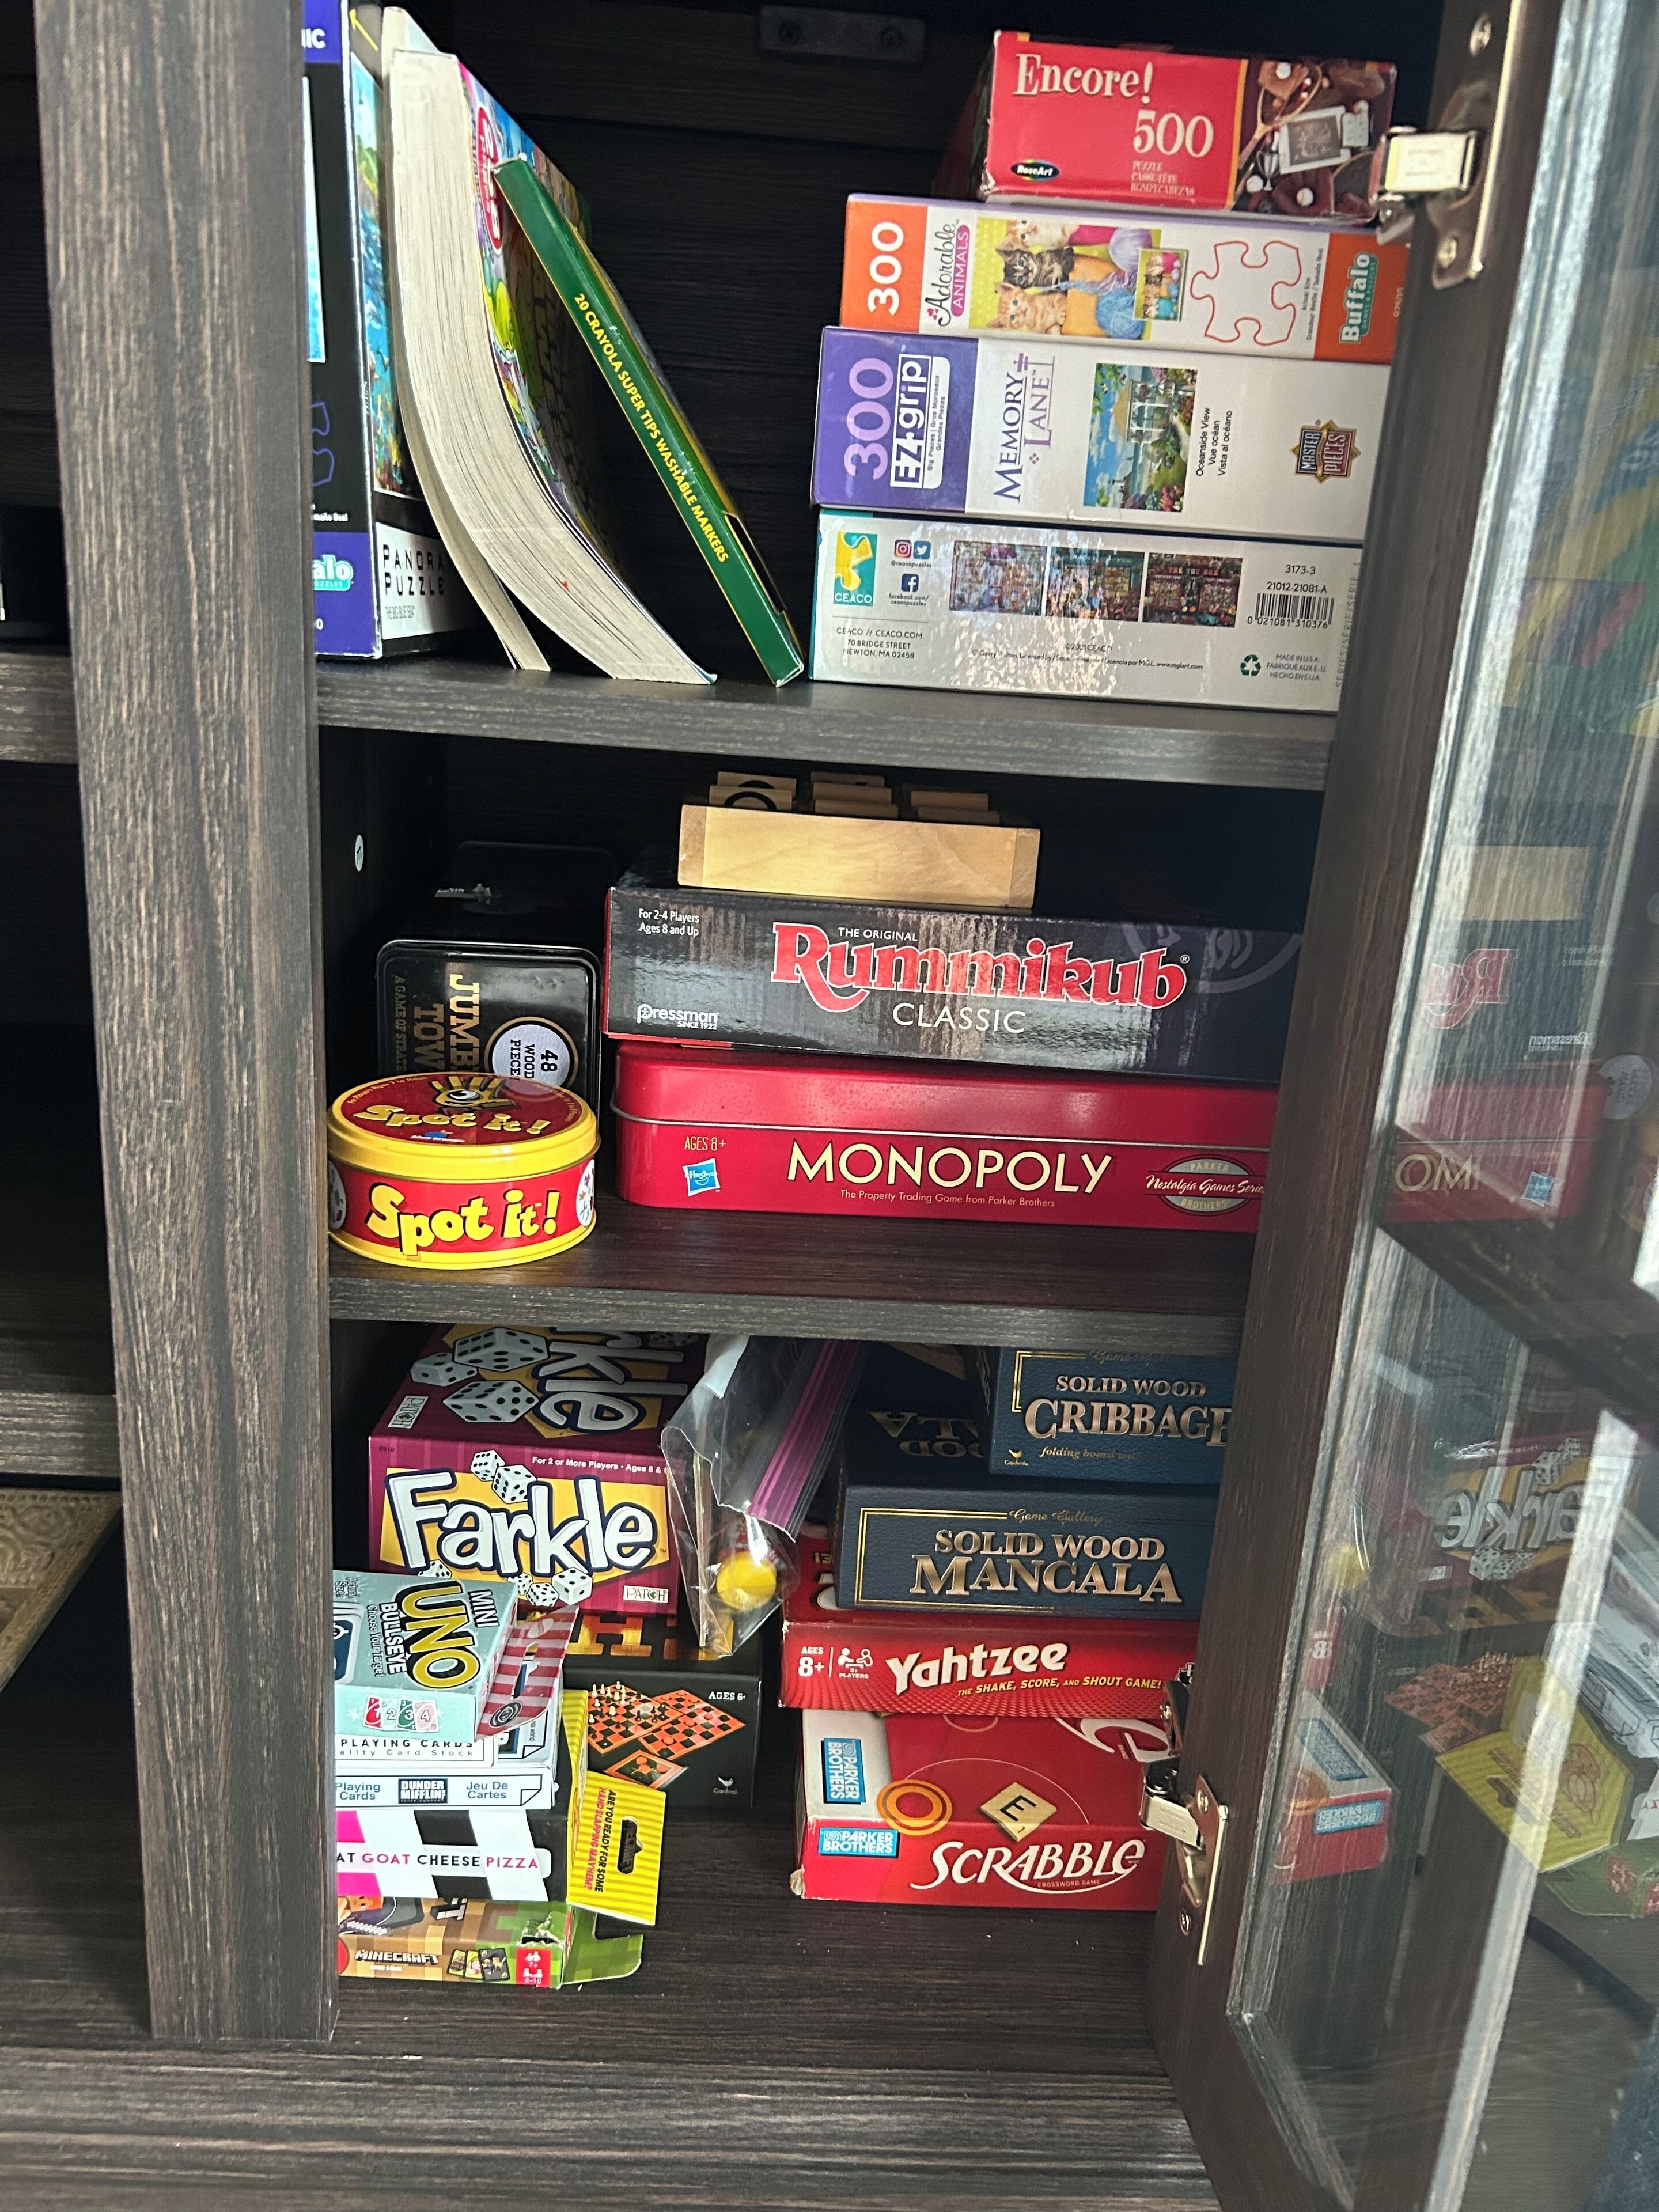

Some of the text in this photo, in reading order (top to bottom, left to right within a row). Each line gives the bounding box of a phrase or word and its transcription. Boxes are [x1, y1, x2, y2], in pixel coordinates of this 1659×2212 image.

[1012, 53, 1153, 104] Encore!
[1134, 109, 1214, 158] 500
[1017, 165, 1053, 177] RoseArt
[1133, 160, 1163, 172] PUZZLE
[868, 222, 904, 316] 300
[925, 224, 956, 326] Adorable
[953, 233, 969, 309] ANIMALS
[1341, 253, 1370, 341] Buffalo
[844, 358, 893, 480] 300
[1024, 378, 1052, 449] LANE
[575, 294, 729, 563] 20 CRAYOLA SUPER TIPS WASHABLE MARKERS
[993, 371, 1024, 503] MEMORY
[1196, 408, 1210, 476] Oceanside View
[1208, 420, 1220, 465] Vue océan
[1218, 454, 1228, 476] Vista
[1223, 411, 1232, 442] océano
[1301, 433, 1321, 469] MASTER
[1323, 434, 1346, 472] PIECES
[1285, 565, 1316, 575] 3173-3
[385, 571, 446, 597] PUZZLE
[1267, 581, 1327, 594] 21012-21081-A
[835, 593, 872, 603] CEACO
[836, 627, 922, 639] CEACO CEACO.COM
[1257, 618, 1328, 629] 021081 310376
[857, 640, 884, 649] BRIDGE
[1138, 658, 1155, 667] MGL
[639, 908, 700, 923] For 2-4 Players
[639, 922, 699, 938] Ages 8 and Up
[838, 927, 918, 942] THE ORIGINAL
[771, 922, 1187, 1012] Rummikub
[449, 974, 480, 1071] JUMB
[701, 1022, 718, 1030] 1922
[893, 1002, 1026, 1034] CLASSIC
[510, 1039, 521, 1077] PIECE
[524, 1044, 535, 1078] WOOD
[541, 1050, 558, 1072] 48
[353, 1104, 551, 1135] Spot it!
[684, 1135, 727, 1151] AGES 8+
[787, 1139, 1112, 1194] MONOPOLY
[1191, 1161, 1229, 1172] PARKER
[1146, 1175, 1234, 1194] Nostalgia Games
[840, 1189, 1055, 1207] The Property Trading Game from Parker Brothers
[1181, 1198, 1228, 1209] BROTHERS
[366, 1185, 560, 1256] Spot it!
[1056, 1376, 1207, 1397] SOLID WOOD
[395, 1397, 426, 1427] PATCH
[1040, 1446, 1080, 1459] folding
[1082, 1448, 1116, 1459] board
[532, 1456, 546, 1464] For
[566, 1459, 586, 1467] More
[589, 1461, 619, 1471] Players
[626, 1464, 646, 1474] Ages
[387, 1472, 656, 1575] Farkle
[1009, 1508, 1103, 1527] Game Gallery
[935, 1530, 1165, 1561] SOLID WOOD
[346, 1578, 358, 1598] Actual
[909, 1554, 1183, 1603] MANCALA
[626, 1586, 667, 1602] PATCH
[468, 1589, 499, 1628] MINI
[367, 1605, 386, 1677] Choose Target
[380, 1603, 407, 1675] BULLSEYE
[397, 1583, 481, 1689] UNO
[801, 1646, 824, 1656] AGES
[798, 1656, 825, 1677] 8+
[885, 1642, 1068, 1696] Yahtzee
[709, 1691, 735, 1700] AGES
[957, 1688, 972, 1696] THE
[975, 1681, 1017, 1694] SHAKE,
[1020, 1677, 1060, 1690] SCORE,
[1082, 1676, 1122, 1686] SHOUT
[1125, 1677, 1162, 1690] GAME!
[341, 1739, 410, 1747] PLAYING
[828, 1742, 845, 1799] BROTHERS
[843, 1757, 860, 1799] PARKER
[336, 1781, 508, 1793] Playing Jeu De
[339, 1790, 507, 1800] Cards Cartes
[400, 1790, 441, 1800] MIFFLIN
[401, 1780, 444, 1790] DUNDER
[713, 1787, 738, 1795] Cardinal
[999, 1794, 1037, 1822] E
[584, 1787, 607, 1890] HAND SLAPPING MAYHEM?
[594, 1790, 616, 1892] ARE YOU READY FOR SOME
[823, 1840, 893, 1854] BROTHERS
[842, 1831, 894, 1843] PARKER
[336, 1852, 539, 1869] AT GOAT CHEESE PIZZA
[1037, 1878, 1101, 1888] CROSSWORD GAME
[355, 1950, 439, 1965] MINECRAFT
